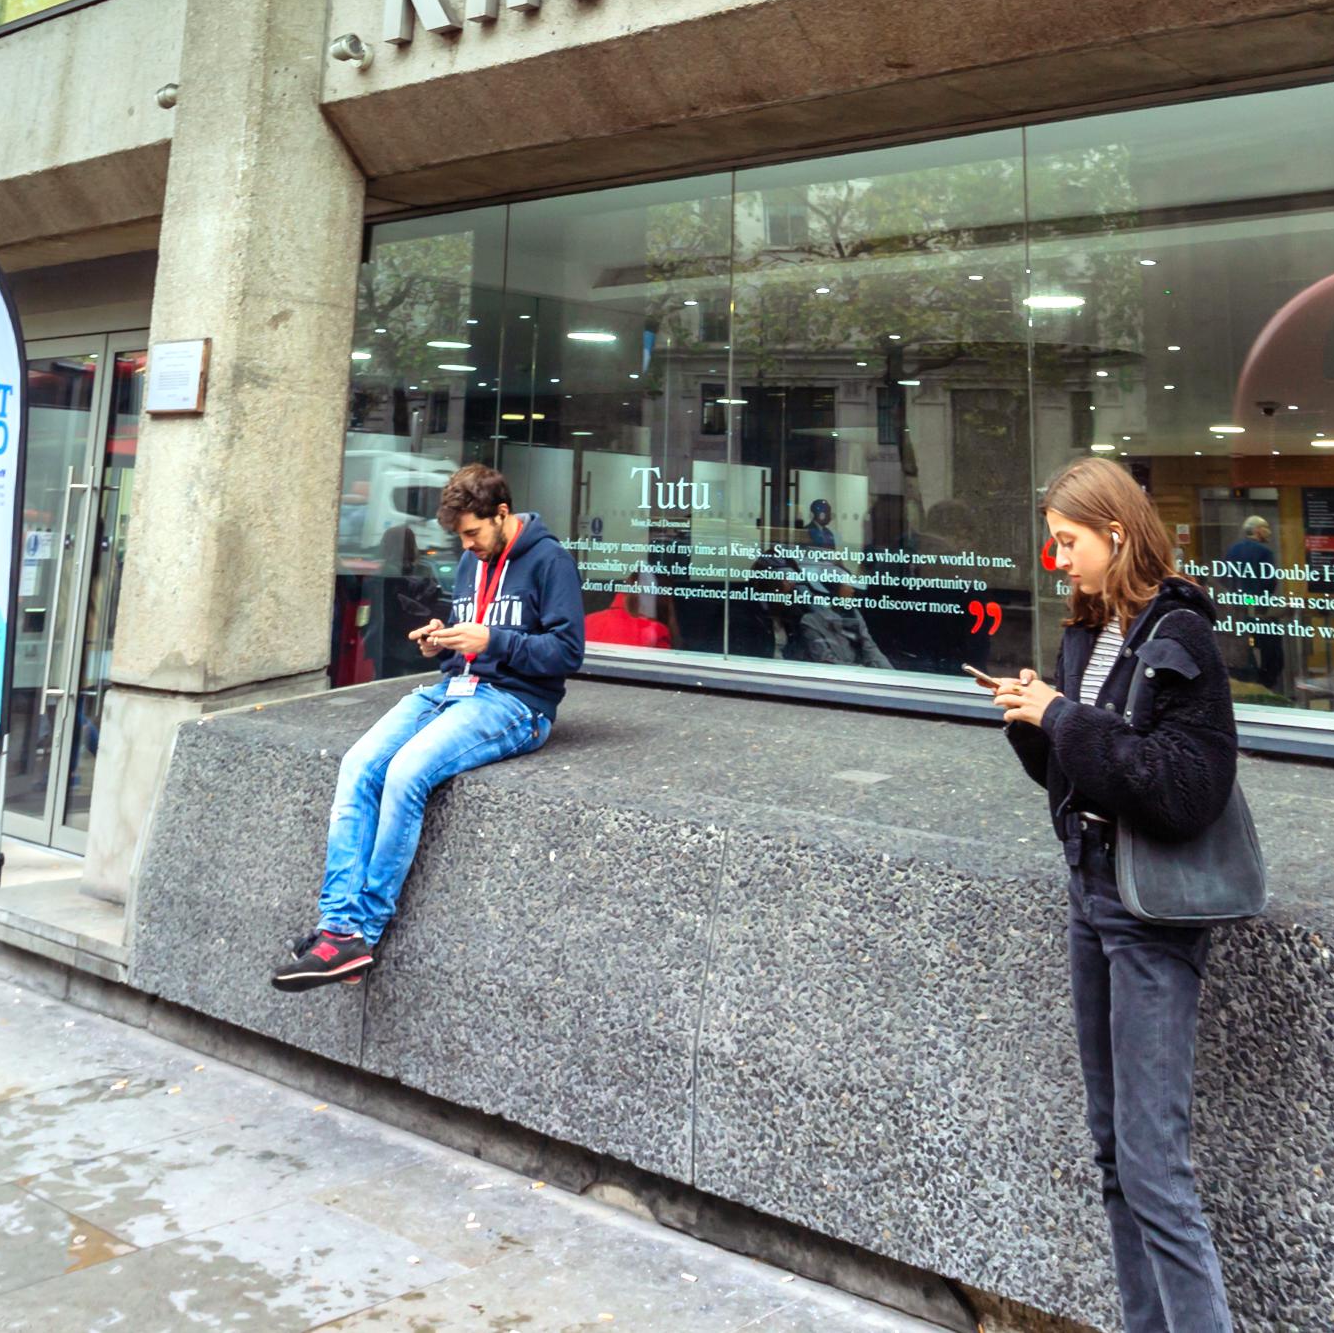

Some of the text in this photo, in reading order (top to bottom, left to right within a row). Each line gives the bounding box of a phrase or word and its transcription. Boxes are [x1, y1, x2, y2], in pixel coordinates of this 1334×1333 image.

[630, 467, 711, 510] Tutu
[560, 537, 591, 552] derful,
[593, 538, 620, 554] happy
[621, 541, 665, 555] memories
[666, 541, 677, 554] of
[677, 544, 693, 556] my
[695, 542, 716, 556] time
[718, 544, 728, 556] at
[774, 544, 806, 561] Study
[807, 547, 848, 562] opened
[850, 552, 865, 564] up
[866, 553, 874, 562] a
[875, 549, 910, 564] whole
[912, 553, 938, 564] new
[939, 551, 974, 566] world
[976, 555, 990, 567] to
[992, 557, 1016, 568] me.
[577, 559, 987, 593] accessibility of books, the freedom to question and to debate and the opportunity to
[1184, 559, 1209, 576] the
[1212, 560, 1257, 579] DNA
[1259, 562, 1320, 582] Double
[581, 579, 965, 615] dom of minds whose experience and learning left me eager to discover more.
[1217, 589, 1286, 607] attitudes
[1289, 591, 1305, 609] in
[1213, 615, 1233, 632] nd
[1235, 618, 1285, 637] points
[1288, 619, 1315, 638] the
